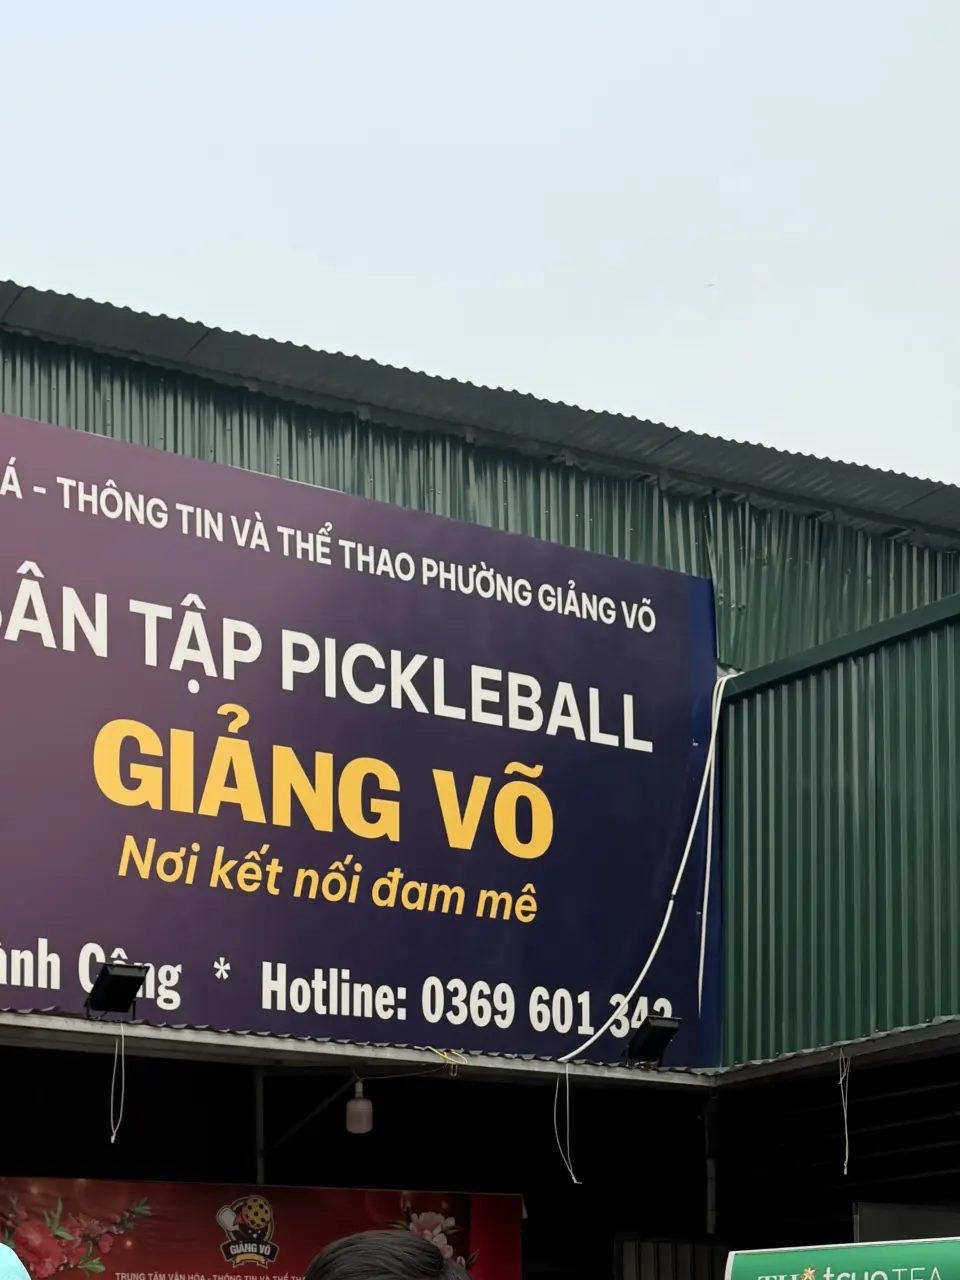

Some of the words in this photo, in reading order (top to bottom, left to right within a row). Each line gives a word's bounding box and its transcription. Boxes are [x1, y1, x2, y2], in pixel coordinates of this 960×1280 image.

[57, 477, 169, 529] THÔNG
[176, 503, 224, 542] TIN
[230, 511, 271, 553] VÀ
[277, 521, 333, 566] THỂ
[339, 538, 415, 582] THAO
[422, 560, 532, 607] PHƯỜNG
[538, 580, 617, 625] GIẢNG
[620, 597, 657, 634] VÕ
[129, 593, 263, 694] TẬP
[281, 628, 654, 754] PICKLEBALL
[92, 703, 401, 843] GIẢNG
[433, 761, 555, 860] VÕ
[117, 834, 201, 886] Nơi
[209, 843, 283, 898] kết
[293, 854, 361, 904] nối
[371, 867, 468, 916] đam
[476, 882, 539, 924] mê
[78, 942, 182, 1010] Cng
[260, 961, 409, 1021] Hotline:
[421, 975, 516, 1030] 0369
[528, 991, 596, 1037] 601
[229, 1241, 257, 1255] GIẢNG
[259, 1244, 271, 1256] VÕ
